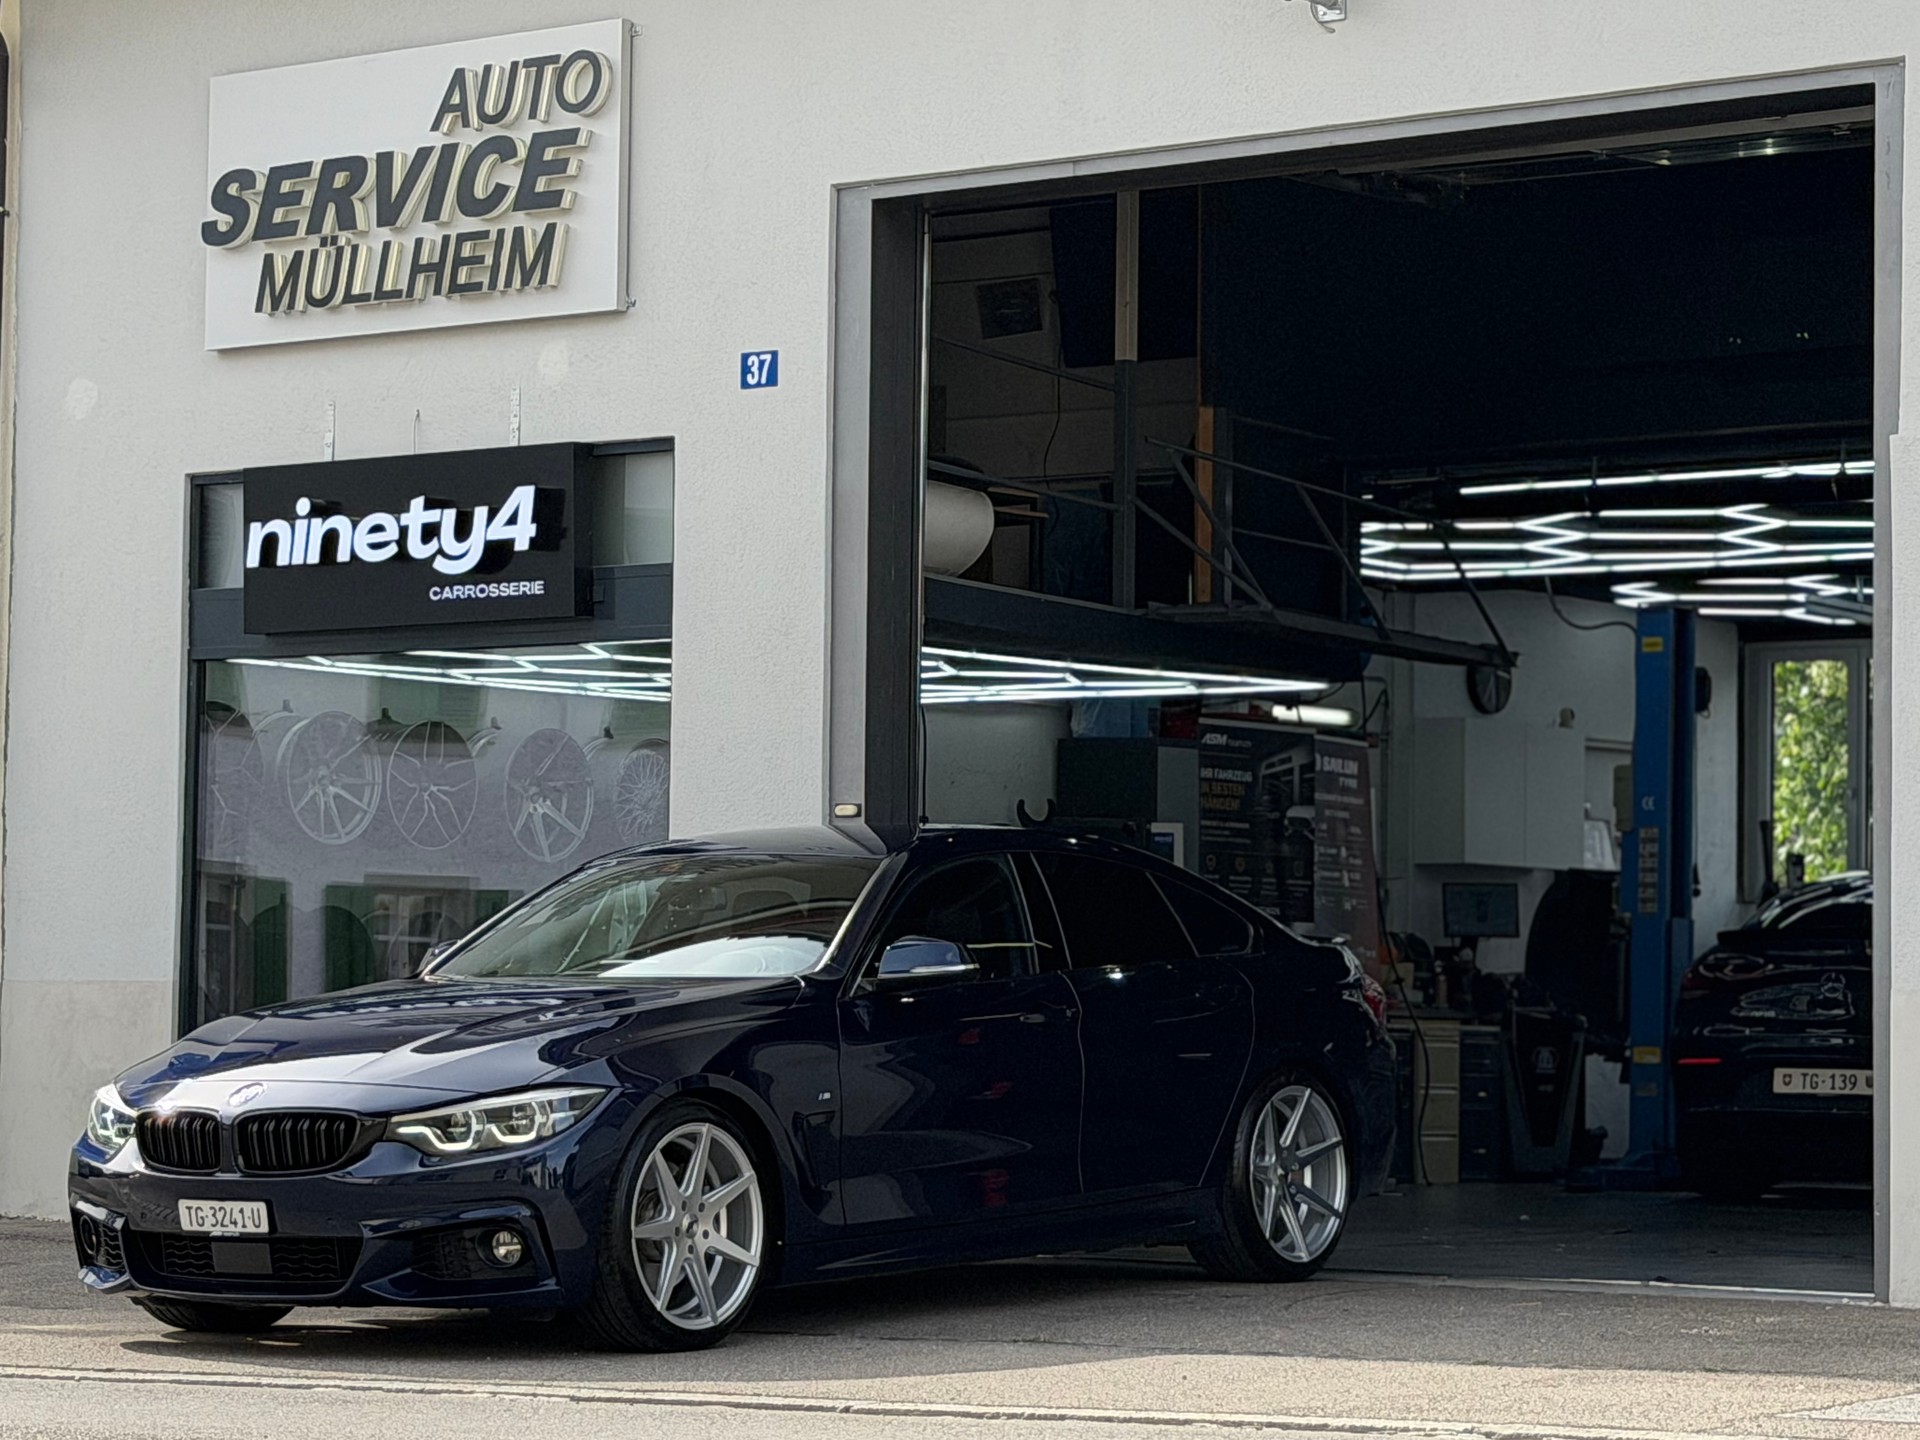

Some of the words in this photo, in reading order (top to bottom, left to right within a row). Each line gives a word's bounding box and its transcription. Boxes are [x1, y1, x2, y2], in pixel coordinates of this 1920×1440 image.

[430, 49, 611, 133] AUTO
[201, 127, 591, 248] SERVICE
[254, 222, 566, 315] MÜLLHEIM
[746, 353, 772, 385] 37
[246, 484, 537, 574] ninety4
[429, 580, 545, 600] CARROSSERIE
[1201, 732, 1228, 746] ASM
